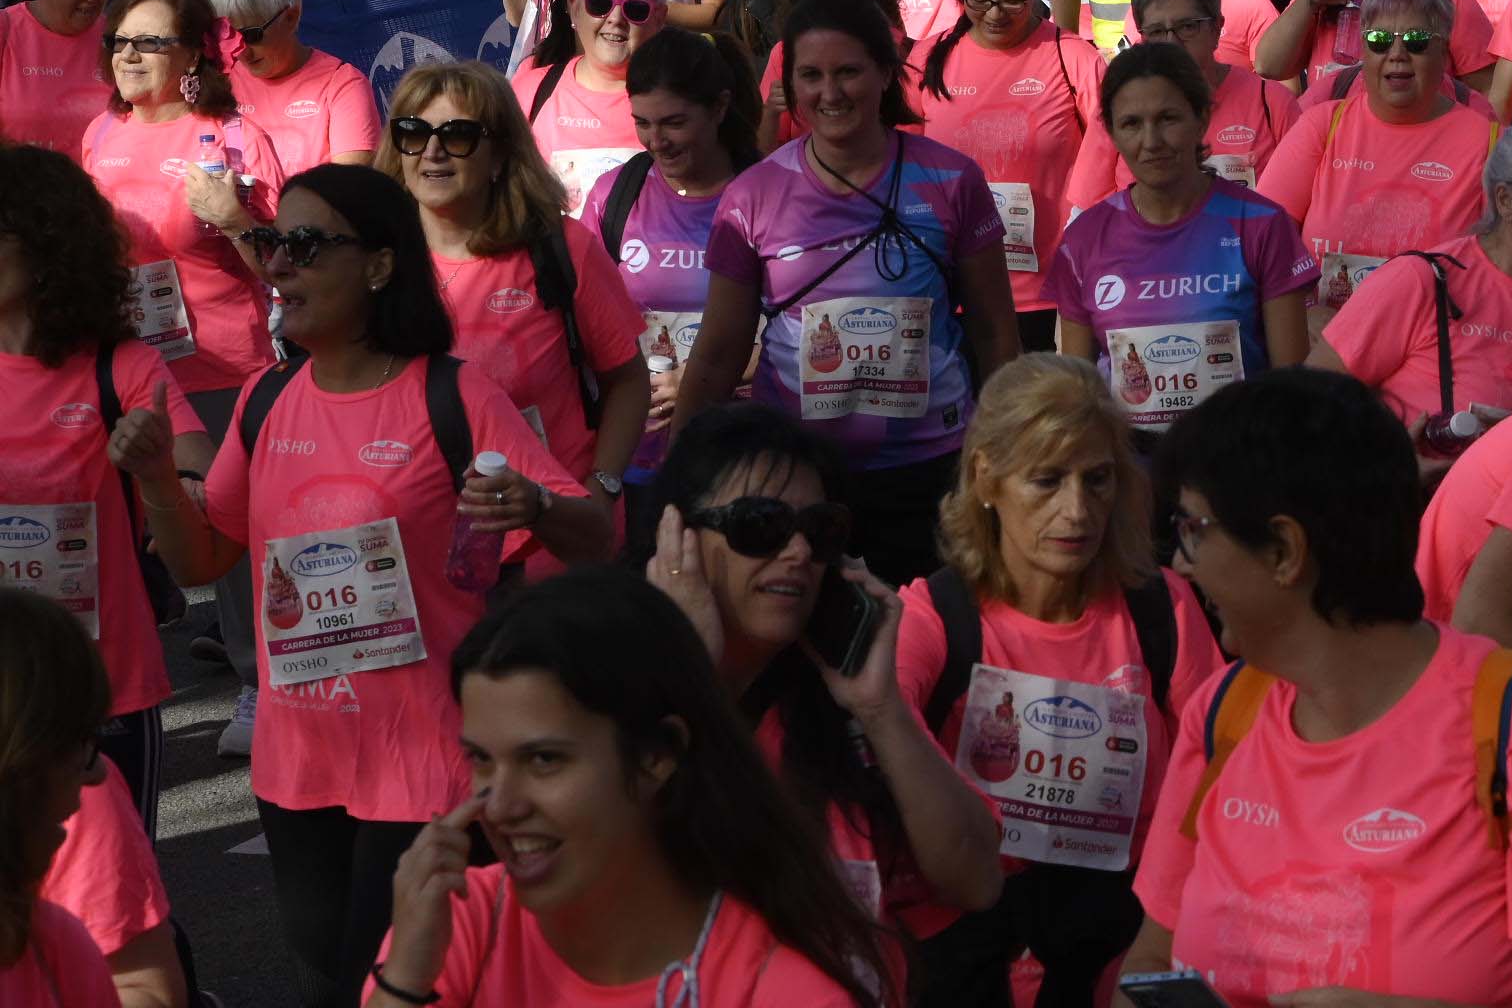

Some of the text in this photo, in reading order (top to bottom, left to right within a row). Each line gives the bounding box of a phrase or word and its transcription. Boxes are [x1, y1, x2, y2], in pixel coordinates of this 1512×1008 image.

[974, 217, 1003, 239] MUJE
[1137, 273, 1240, 300] ZURICH
[841, 317, 894, 329] ASTURIANA
[846, 345, 891, 361] 016
[1149, 346, 1197, 358] ASTURIANA
[852, 365, 885, 377] 17334
[1155, 372, 1198, 392] 016
[881, 398, 919, 409] Santander
[1160, 396, 1194, 408] 19482
[362, 449, 413, 462] ASTURIANA
[360, 541, 389, 552] SUMA
[297, 555, 354, 571] ASTURIANA
[307, 585, 358, 611] 016
[316, 612, 355, 630] 10961
[281, 623, 403, 651] CARRERA DE LA MUJER 2023
[283, 643, 410, 673] OYSHO Santander
[1030, 709, 1096, 732] ASTURIANA
[1108, 713, 1136, 726] SUMA
[1024, 749, 1087, 781] 016
[1025, 783, 1075, 804] 21878
[1028, 809, 1044, 820] DE
[1045, 812, 1059, 822] LA
[1060, 813, 1095, 825] MUJER
[1351, 826, 1418, 842] ASTURIANA
[1065, 837, 1118, 855] Santander
